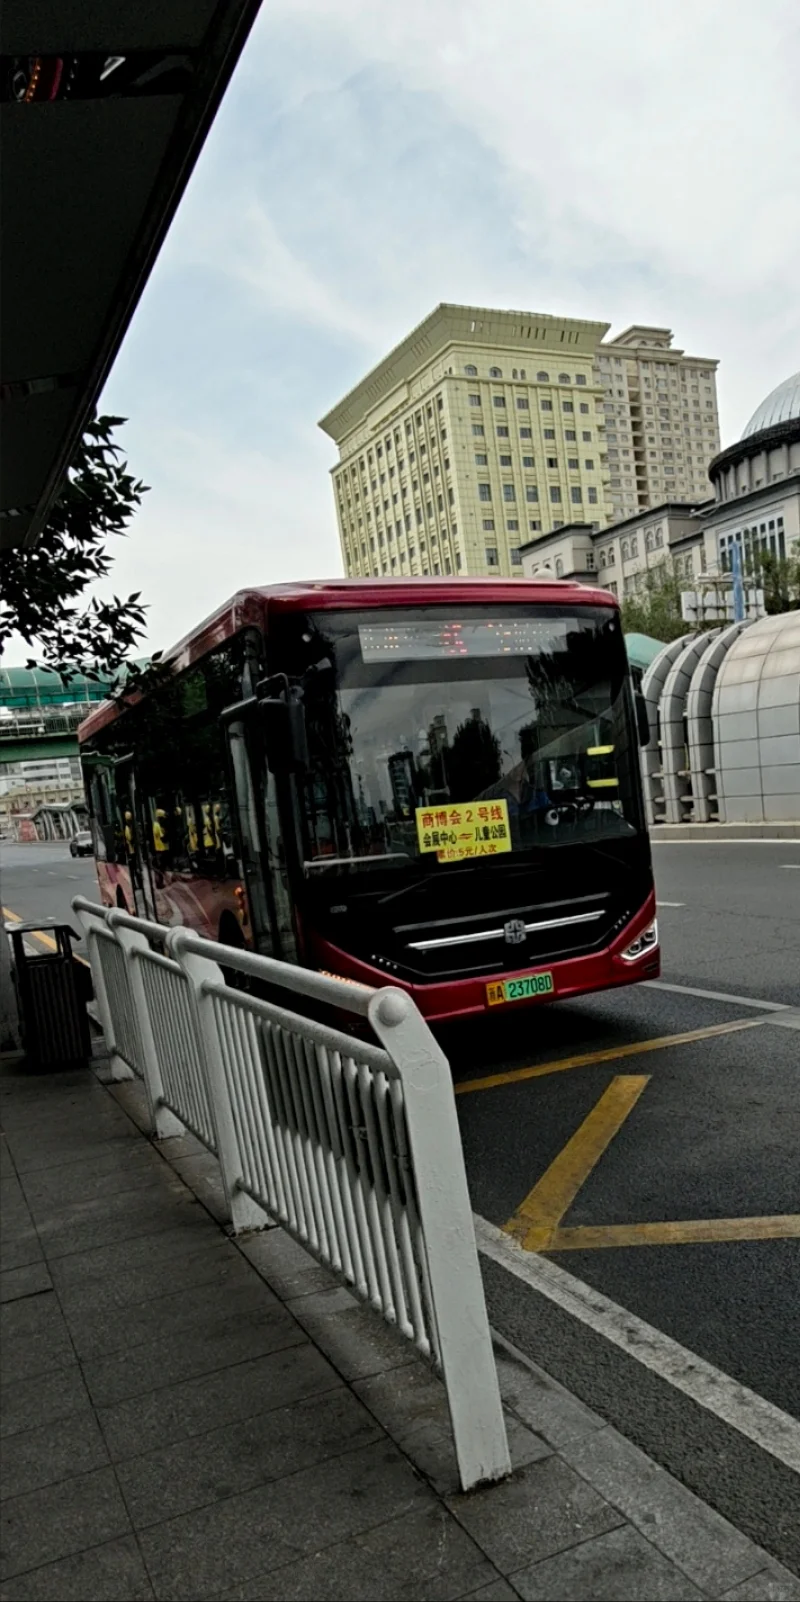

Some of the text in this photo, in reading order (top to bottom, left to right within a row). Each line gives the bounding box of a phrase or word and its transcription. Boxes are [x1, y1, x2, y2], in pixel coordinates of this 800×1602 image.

[423, 824, 507, 848] 会展中心 儿童公园
